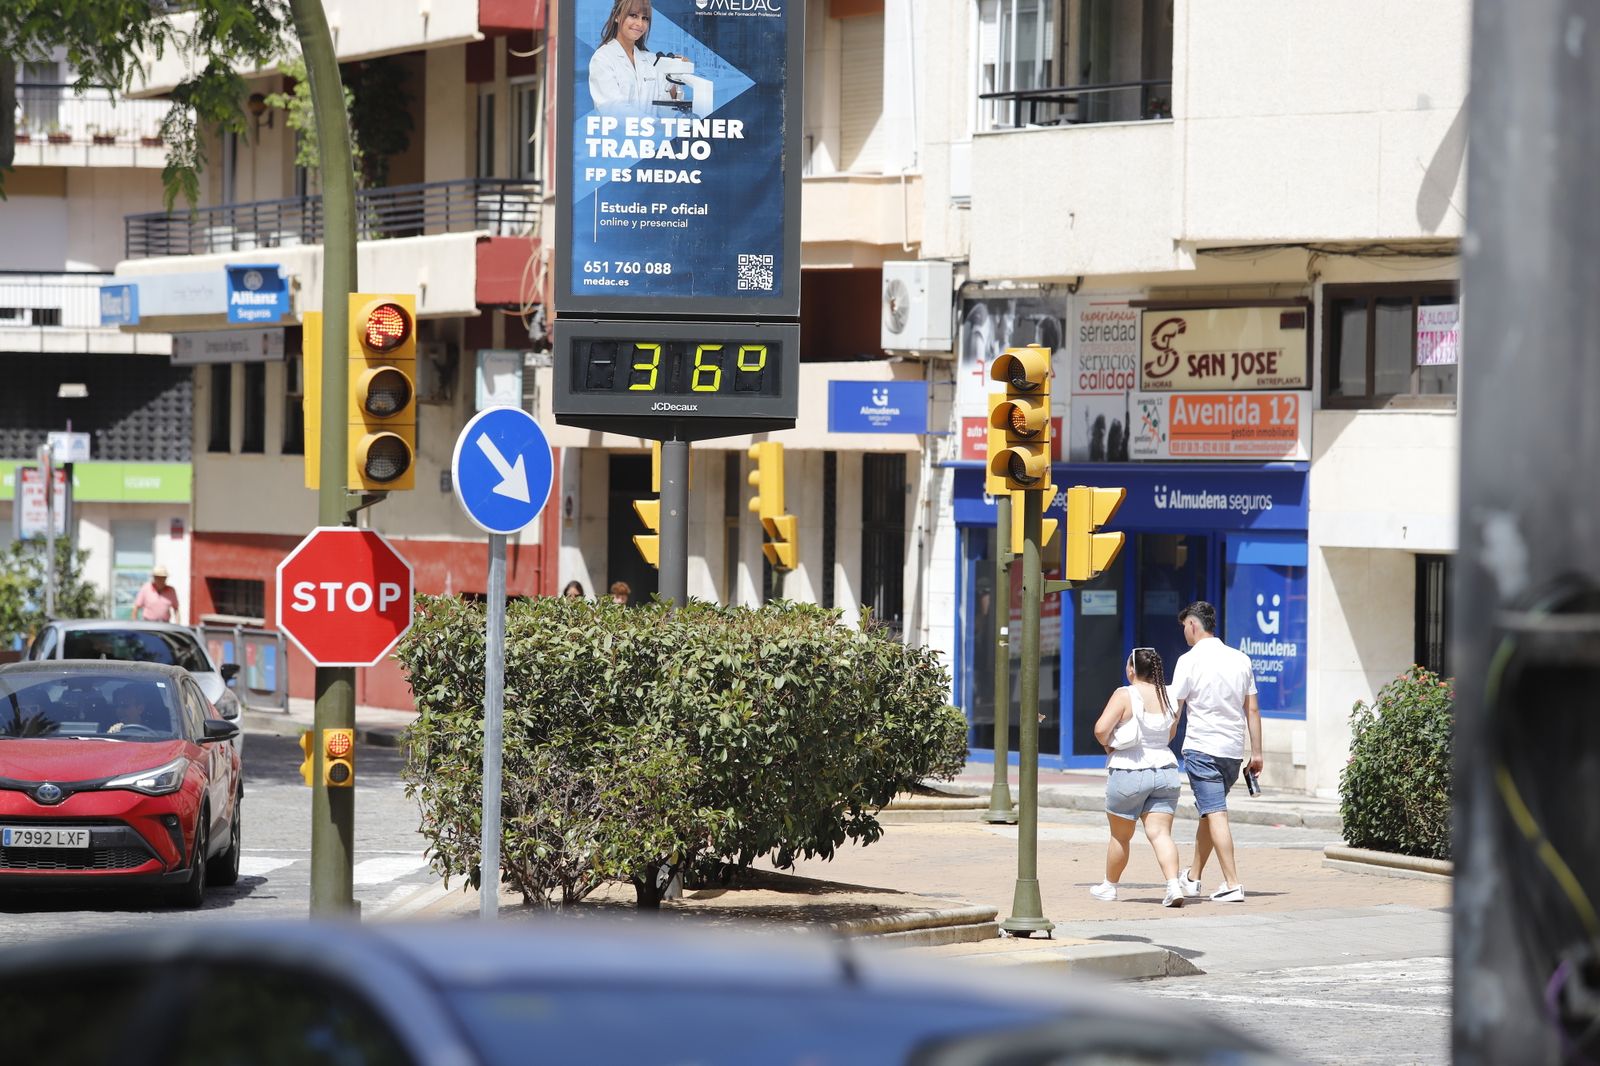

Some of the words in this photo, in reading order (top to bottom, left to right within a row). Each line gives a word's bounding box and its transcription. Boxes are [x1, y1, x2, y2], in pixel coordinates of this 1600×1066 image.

[709, 0, 781, 11] MEDAC
[586, 116, 618, 136] FP
[625, 117, 656, 137] ES
[660, 118, 744, 139] TENER
[585, 138, 711, 161] TRABAJO
[585, 168, 607, 182] FP
[611, 169, 632, 183] ES
[636, 169, 702, 184] MEDAC
[600, 202, 647, 214] Estudia
[651, 203, 668, 214] FP
[671, 203, 708, 215] oficial
[600, 217, 629, 227] online
[631, 219, 638, 229] y
[640, 218, 689, 229] presencial
[583, 260, 610, 273] 651
[614, 261, 641, 275] 760
[645, 262, 672, 275] 088
[583, 276, 630, 287] medac.es
[232, 290, 278, 306] Allianz
[237, 307, 277, 321] Seguros
[1079, 320, 1136, 342] seriedad
[1079, 354, 1136, 371] servicios
[1187, 353, 1226, 380] SAN
[1231, 351, 1278, 381] JOSE
[1079, 368, 1136, 390] calidad
[1257, 376, 1303, 386] ENTREPLANTA
[651, 402, 698, 412] JCDecaux
[860, 406, 901, 416] Almudena
[1172, 396, 1261, 426] Avenida
[1269, 396, 1297, 425] 12
[1169, 493, 1228, 511] Almudena
[1228, 493, 1273, 515] seguros
[1402, 526, 1408, 539] 7
[291, 581, 403, 614] STOP
[1239, 637, 1298, 657] Almudena
[1251, 659, 1284, 674] seguros
[14, 831, 52, 845] 7992
[57, 831, 86, 846] LXF
